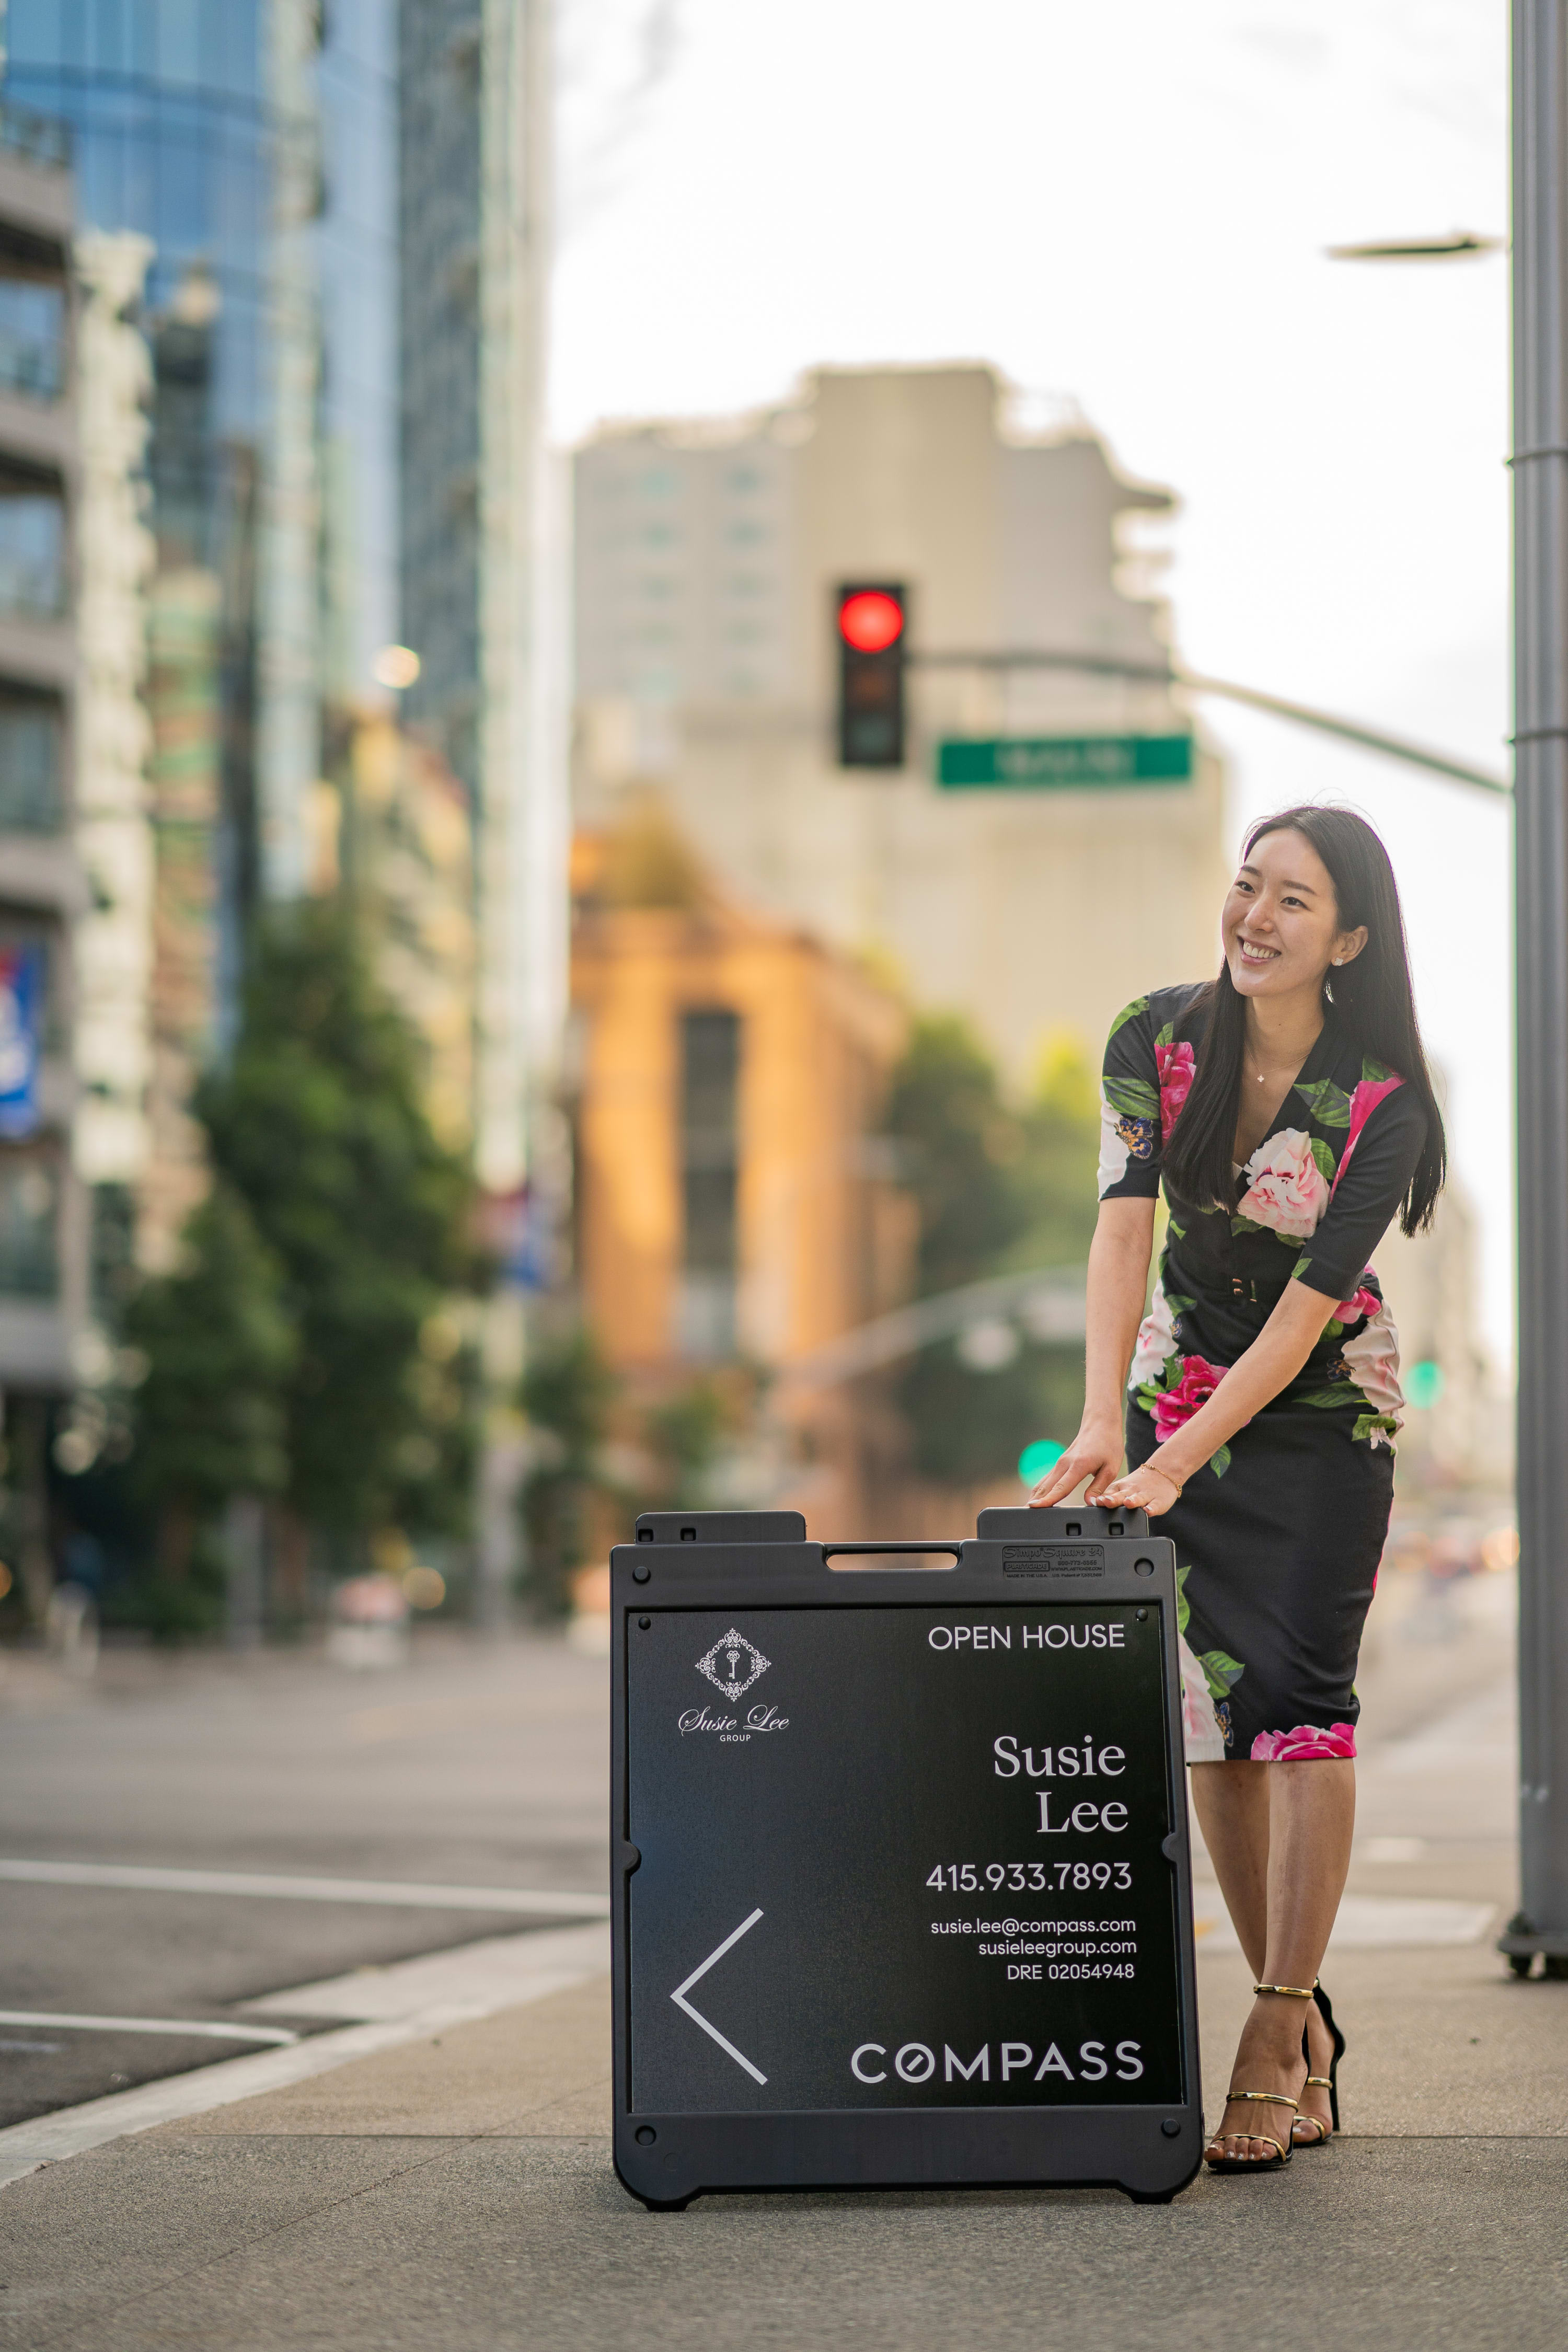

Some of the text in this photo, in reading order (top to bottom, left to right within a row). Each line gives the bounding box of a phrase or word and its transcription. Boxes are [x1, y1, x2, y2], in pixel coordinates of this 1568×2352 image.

[1043, 1548, 1086, 1559] Square
[1088, 1547, 1103, 1557] 24
[928, 1624, 1125, 1650] OPEN HOUSE
[678, 1704, 790, 1737] Susie Lee
[994, 1735, 1126, 1777] Susie
[1035, 1792, 1129, 1833] Lee
[926, 1862, 1133, 1892] 415.933.7893
[931, 1918, 1136, 1936] susie.lee@compass.com
[978, 1939, 1137, 1958] susieleegroup.com
[1007, 1963, 1135, 1980] DRE 02054948
[851, 2040, 1144, 2084] COMPASS
